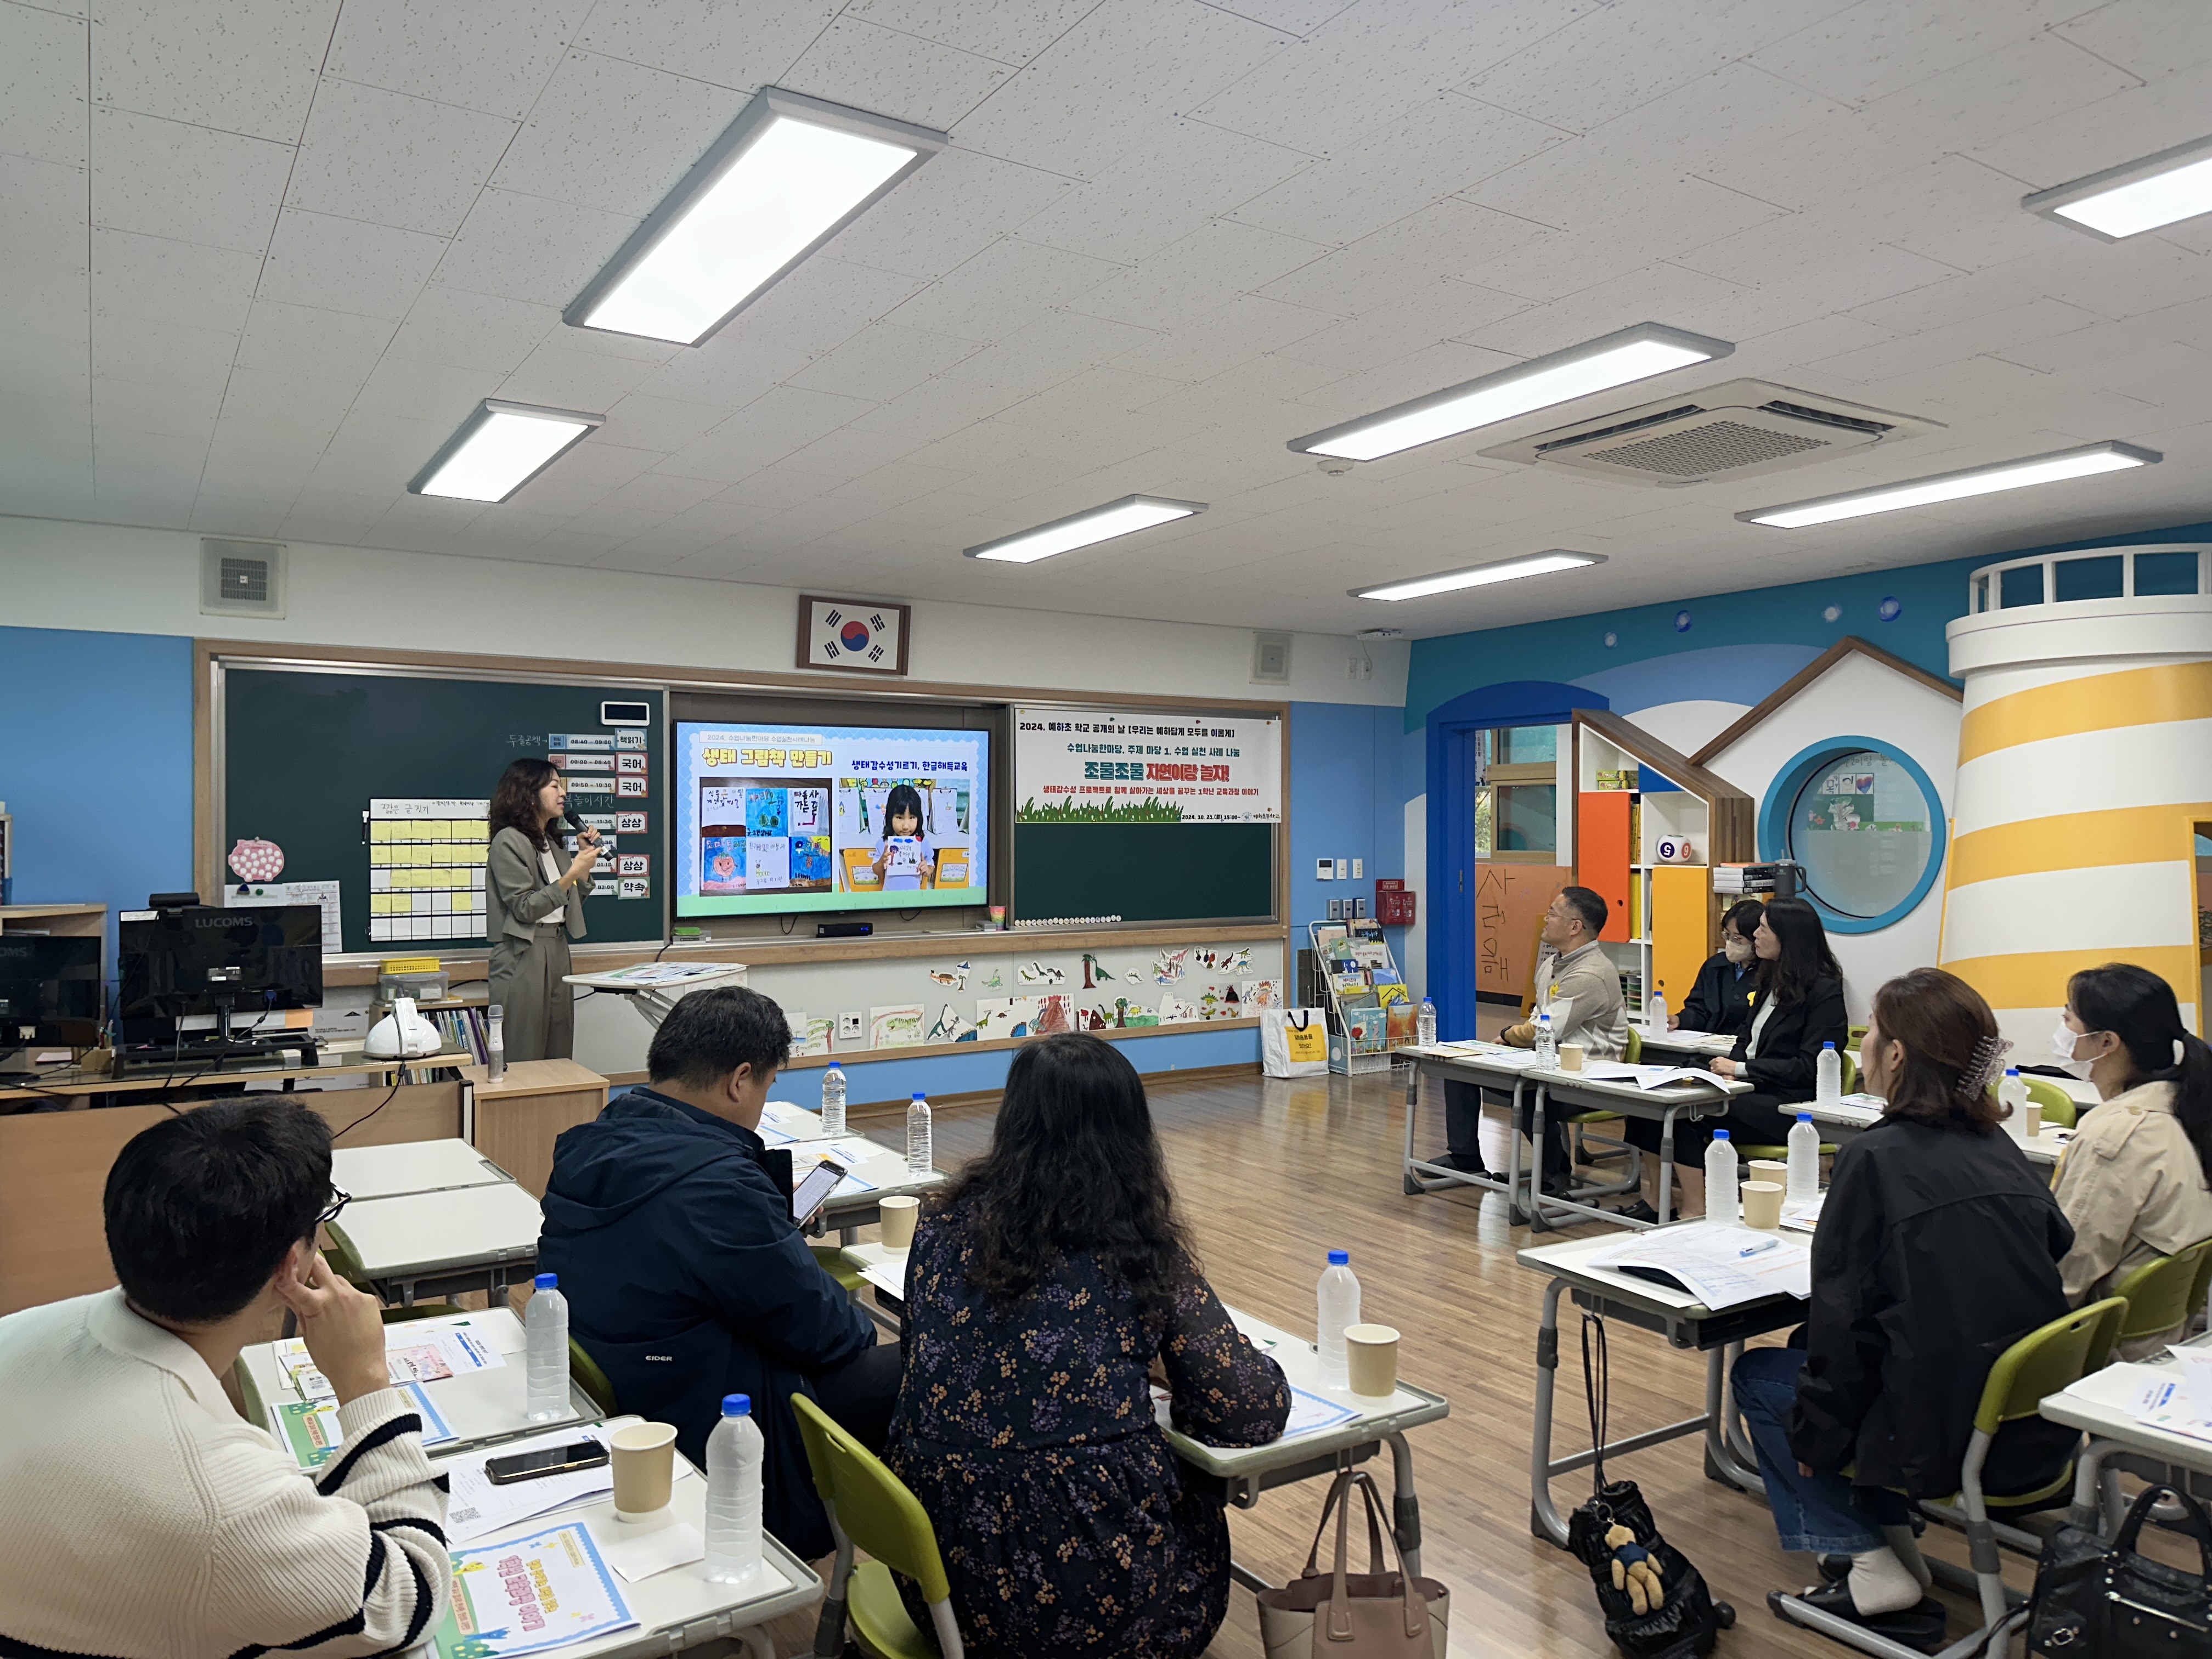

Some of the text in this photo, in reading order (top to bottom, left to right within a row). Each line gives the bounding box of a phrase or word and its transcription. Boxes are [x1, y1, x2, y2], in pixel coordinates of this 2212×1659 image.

[1020, 723, 1045, 731] 2024.
[1048, 722, 1072, 732] 예하초
[1075, 723, 1090, 732] 학교
[1093, 724, 1114, 733] 공개의
[1118, 725, 1125, 734] 날
[1128, 725, 1153, 735] [우리는
[1156, 726, 1184, 736] 예하답게
[1188, 728, 1207, 737] 모두를
[1128, 746, 1143, 754] 주제
[1147, 746, 1161, 755] 마당
[1175, 747, 1188, 756] 수업
[1192, 747, 1206, 756] 실천
[1209, 748, 1223, 757] 사례
[1226, 748, 1240, 757] 나눔
[702, 747, 832, 768] 생태 그림책 만들기
[622, 759, 641, 769] 국어
[851, 760, 968, 771] 생태감수성기르기, 한글해득교육
[1085, 761, 1229, 782] 조물조물 자연이랑 놀자!
[622, 782, 641, 792] 국어
[1043, 786, 1076, 794] 생태감수성
[1115, 786, 1127, 794] 함께
[405, 804, 413, 814] 글
[622, 819, 642, 828] 상상
[1663, 845, 1672, 856] 5
[623, 861, 644, 871] 상상
[624, 882, 645, 892] 약속
[195, 917, 253, 928] LUCOMS
[0, 947, 27, 957] OMS
[497, 1555, 546, 1632] 1학년 교육과정 이야기
